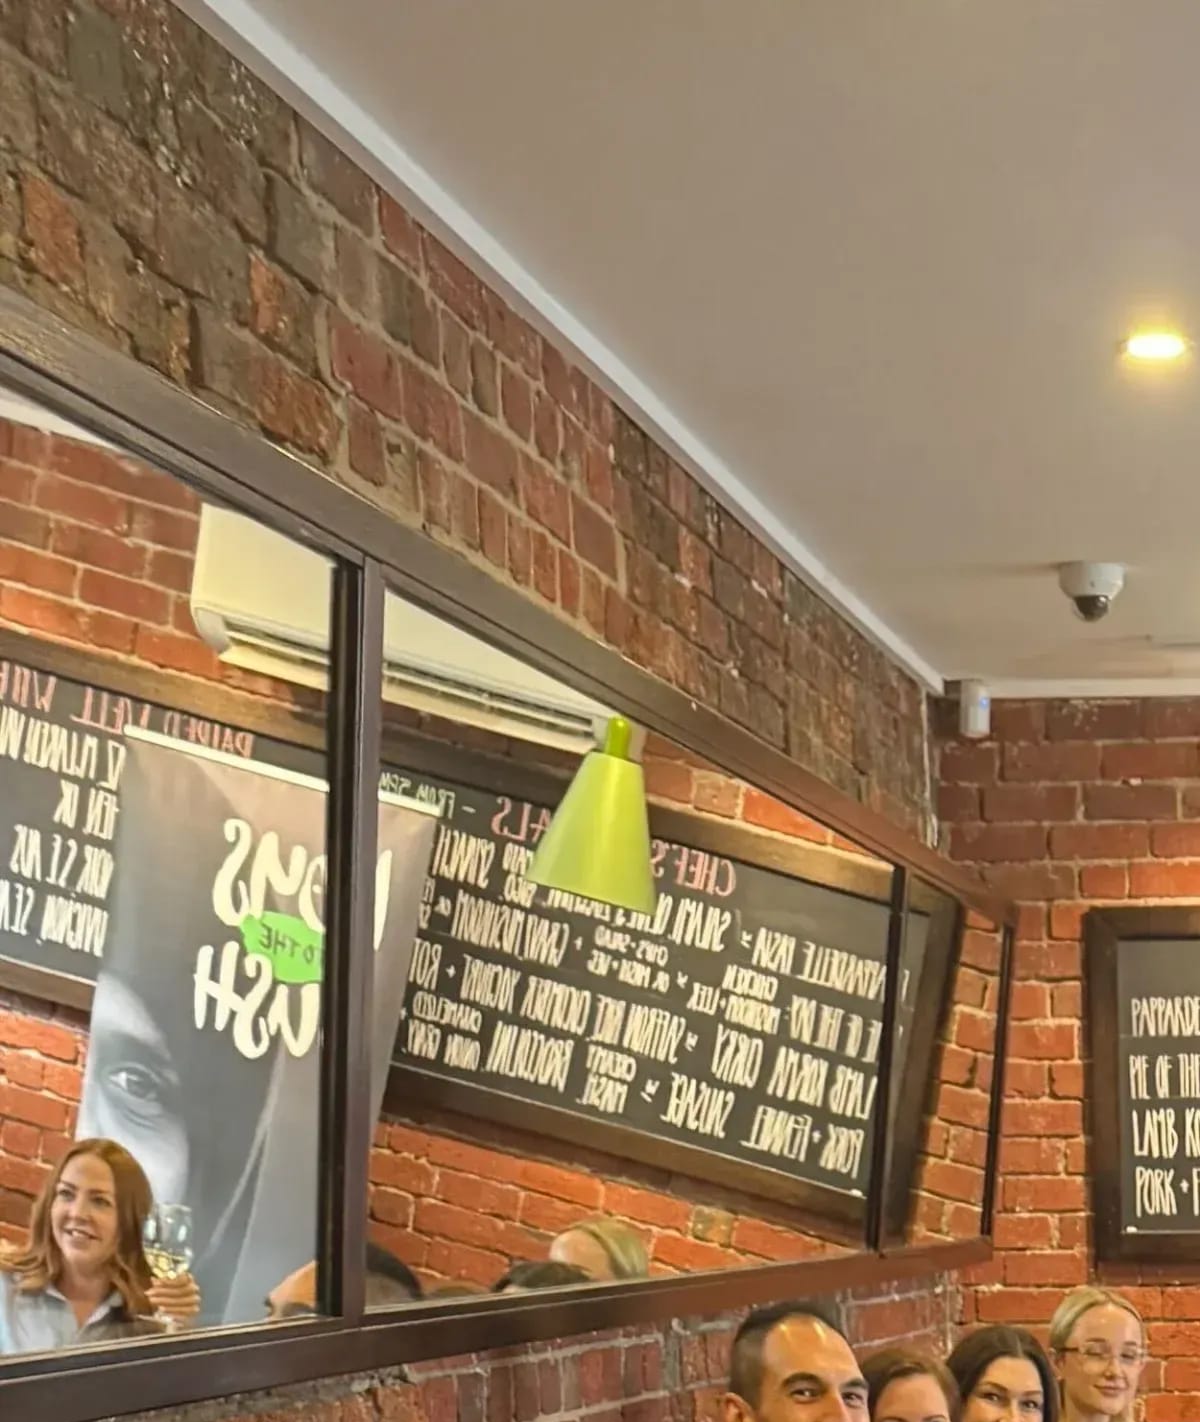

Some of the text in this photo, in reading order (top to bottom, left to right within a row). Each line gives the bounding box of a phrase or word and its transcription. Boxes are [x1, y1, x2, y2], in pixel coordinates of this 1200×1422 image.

[1129, 1054, 1151, 1100] PIE
[1155, 1055, 1173, 1099] OF
[1132, 1107, 1179, 1159] LAMB
[1135, 1166, 1178, 1218] PORK
